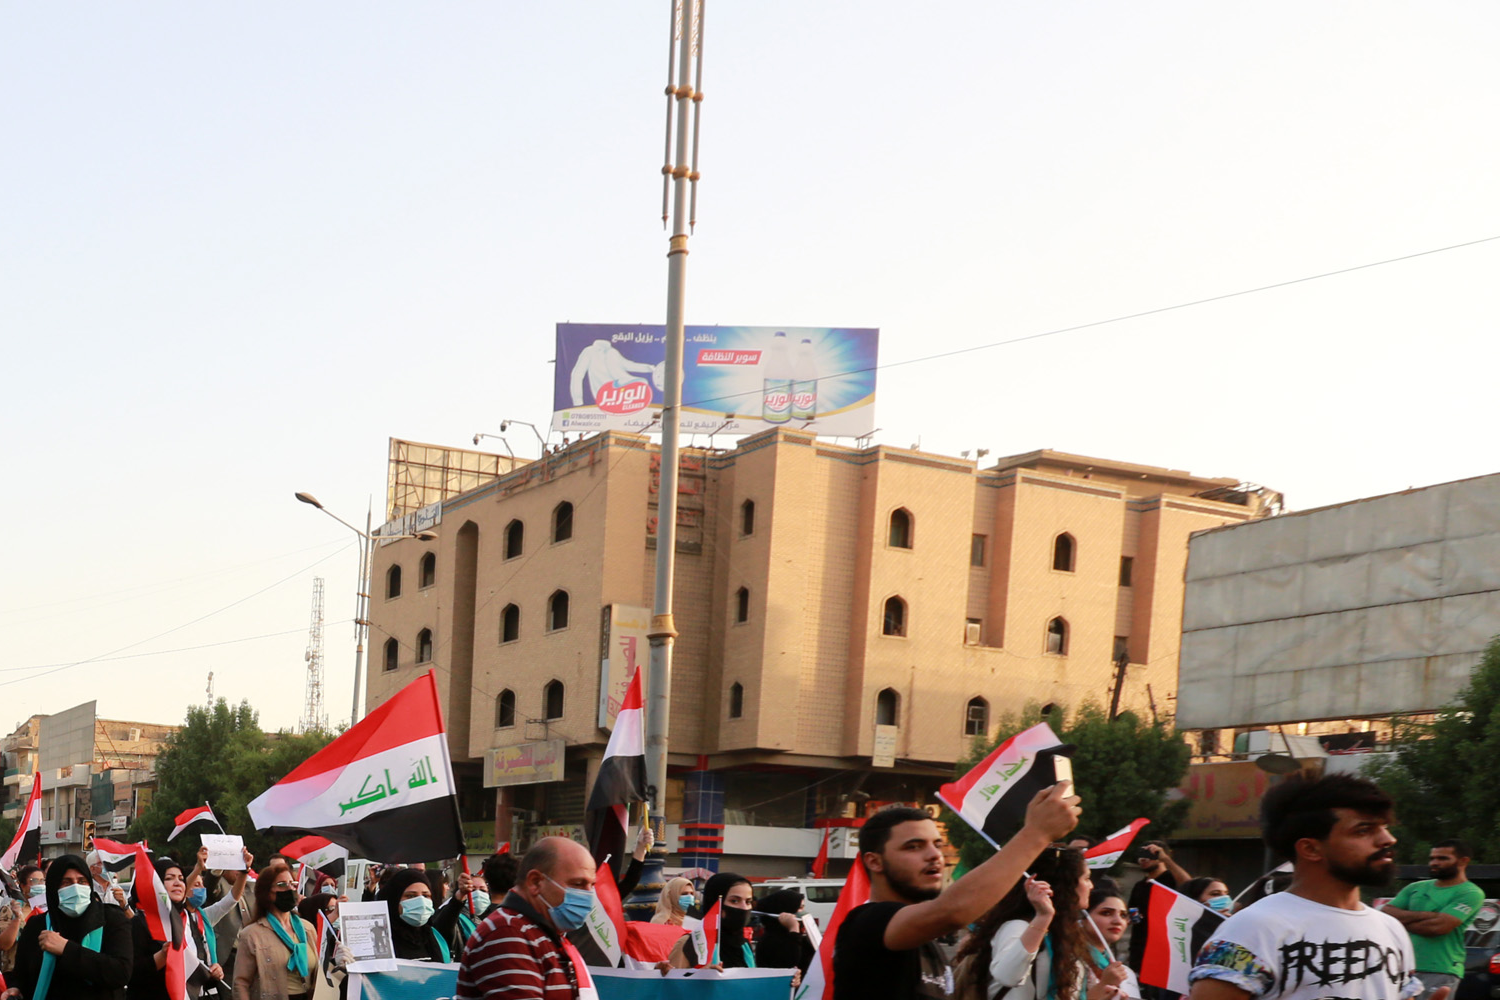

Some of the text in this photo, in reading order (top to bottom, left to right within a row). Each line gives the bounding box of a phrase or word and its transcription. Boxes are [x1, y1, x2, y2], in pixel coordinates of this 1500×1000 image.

[611, 332, 634, 344] البقع
[635, 332, 653, 344] يزيل
[701, 351, 758, 364] سوبر النظافة
[599, 384, 647, 407] الوزير
[408, 755, 438, 789] الله
